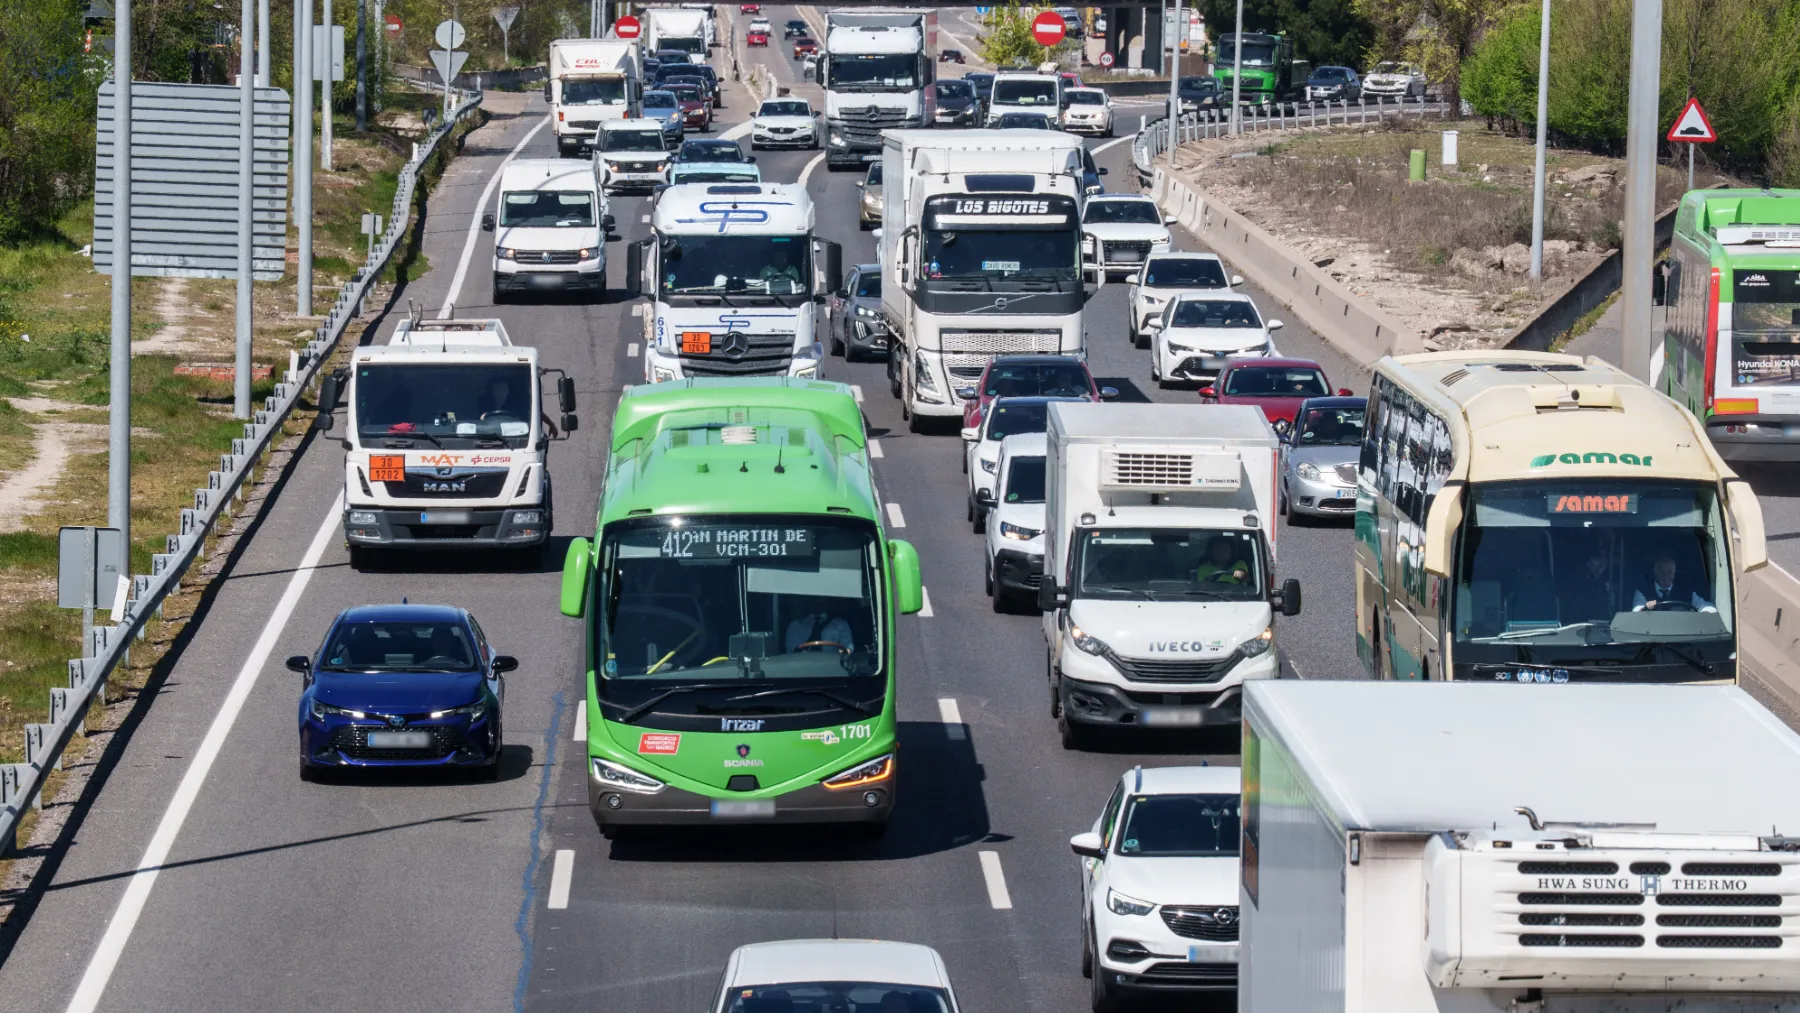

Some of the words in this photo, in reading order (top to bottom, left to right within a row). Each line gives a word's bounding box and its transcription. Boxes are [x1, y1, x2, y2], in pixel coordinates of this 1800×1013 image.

[955, 200, 983, 214] LOS
[987, 200, 1049, 214] BIGOTES
[692, 333, 701, 341] 33
[688, 343, 705, 352] 1203
[1737, 360, 1773, 369] Hyundai
[381, 457, 393, 467] 30
[420, 454, 464, 466] MAT
[1530, 452, 1653, 468] samar
[375, 470, 399, 479] 1202
[423, 483, 466, 492] MAN
[1555, 495, 1629, 512] samar
[662, 530, 693, 558] 412
[716, 529, 779, 543] MARTIN
[785, 529, 806, 543] DE
[716, 544, 788, 556] VCM-301
[1149, 641, 1203, 652] IVECO
[840, 724, 871, 739] 1701
[723, 759, 764, 767] SCANIA
[1537, 878, 1577, 889] HWA
[1582, 878, 1629, 889] SUNG
[1672, 879, 1748, 891] THERMO
